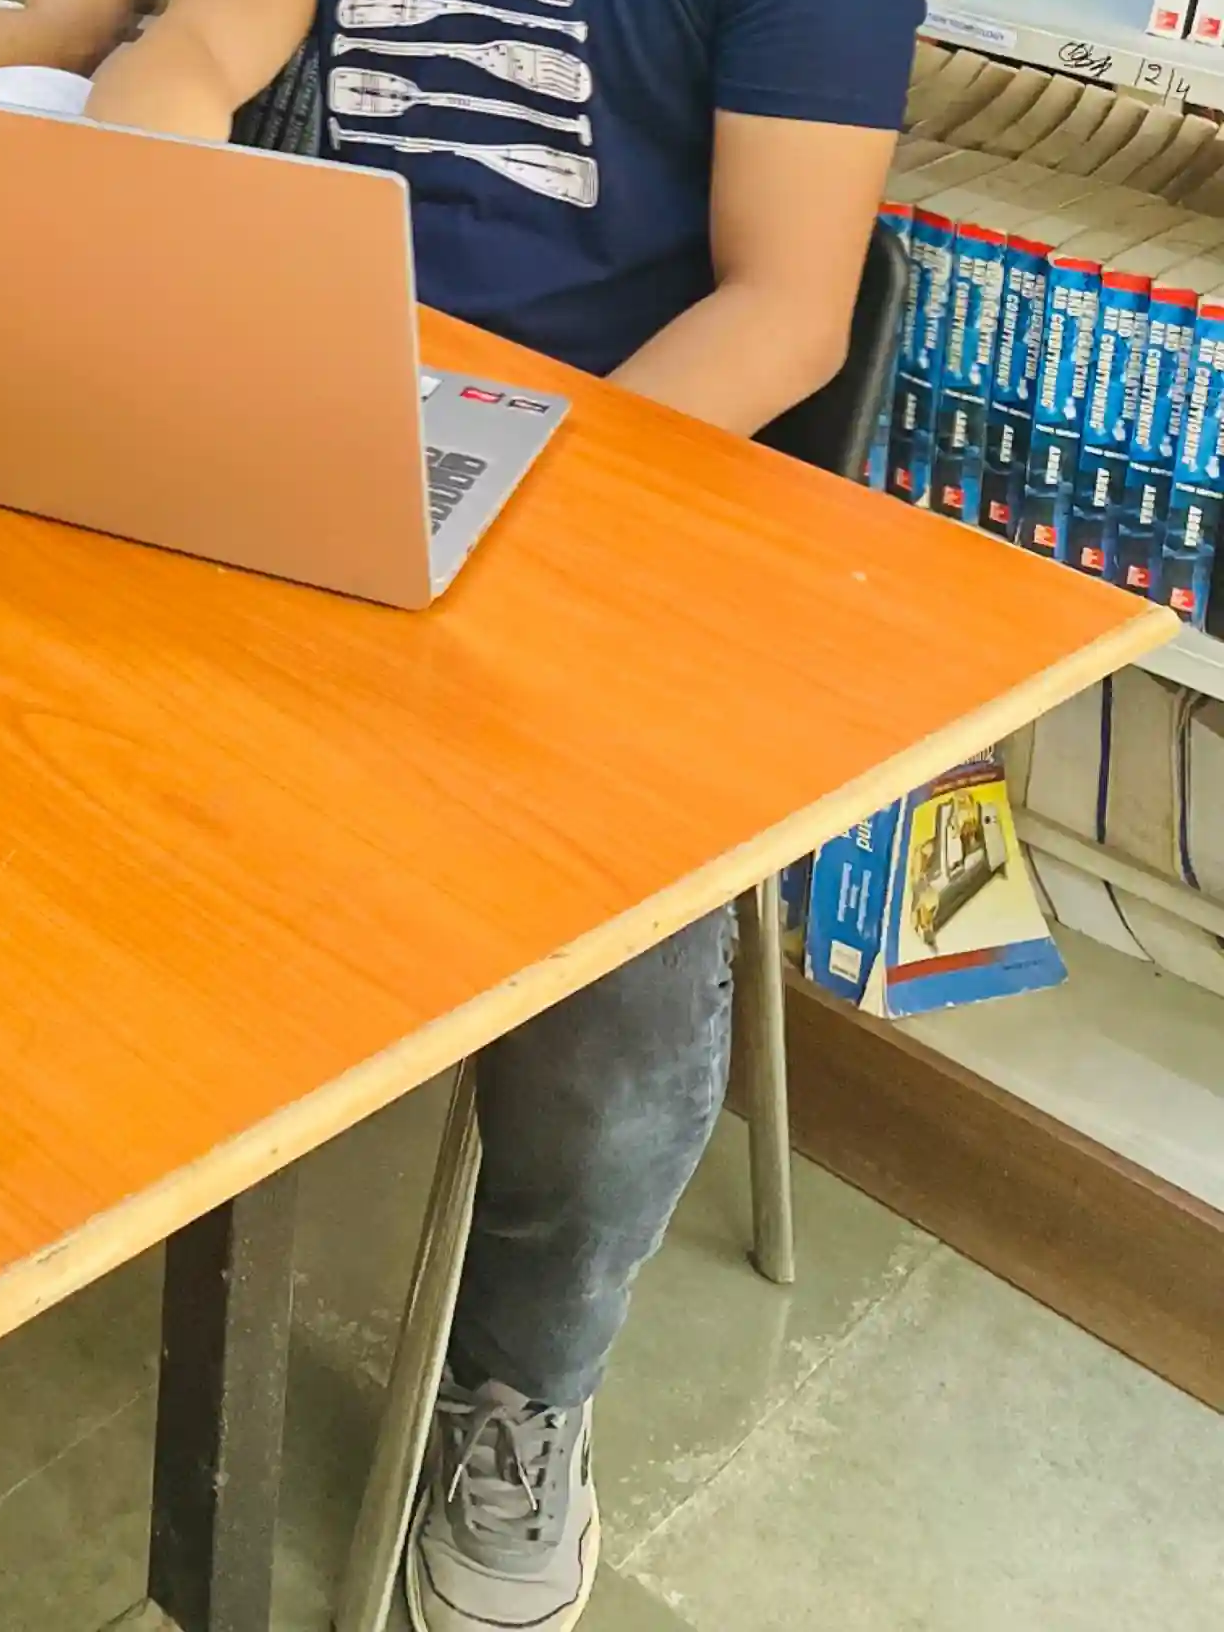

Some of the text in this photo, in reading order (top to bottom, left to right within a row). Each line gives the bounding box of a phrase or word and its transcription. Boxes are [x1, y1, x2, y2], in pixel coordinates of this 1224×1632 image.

[1040, 285, 1069, 409] AIR CONDITIONING
[1088, 306, 1120, 430] AIR CONDITIONING
[1135, 320, 1166, 446] AIR CONDITIONING
[1181, 367, 1211, 466] CONDITIONING
[1044, 445, 1062, 485] ARORA
[1092, 467, 1111, 508] ARORA
[1139, 484, 1157, 525] ARORA
[1184, 504, 1203, 548] ARORA
